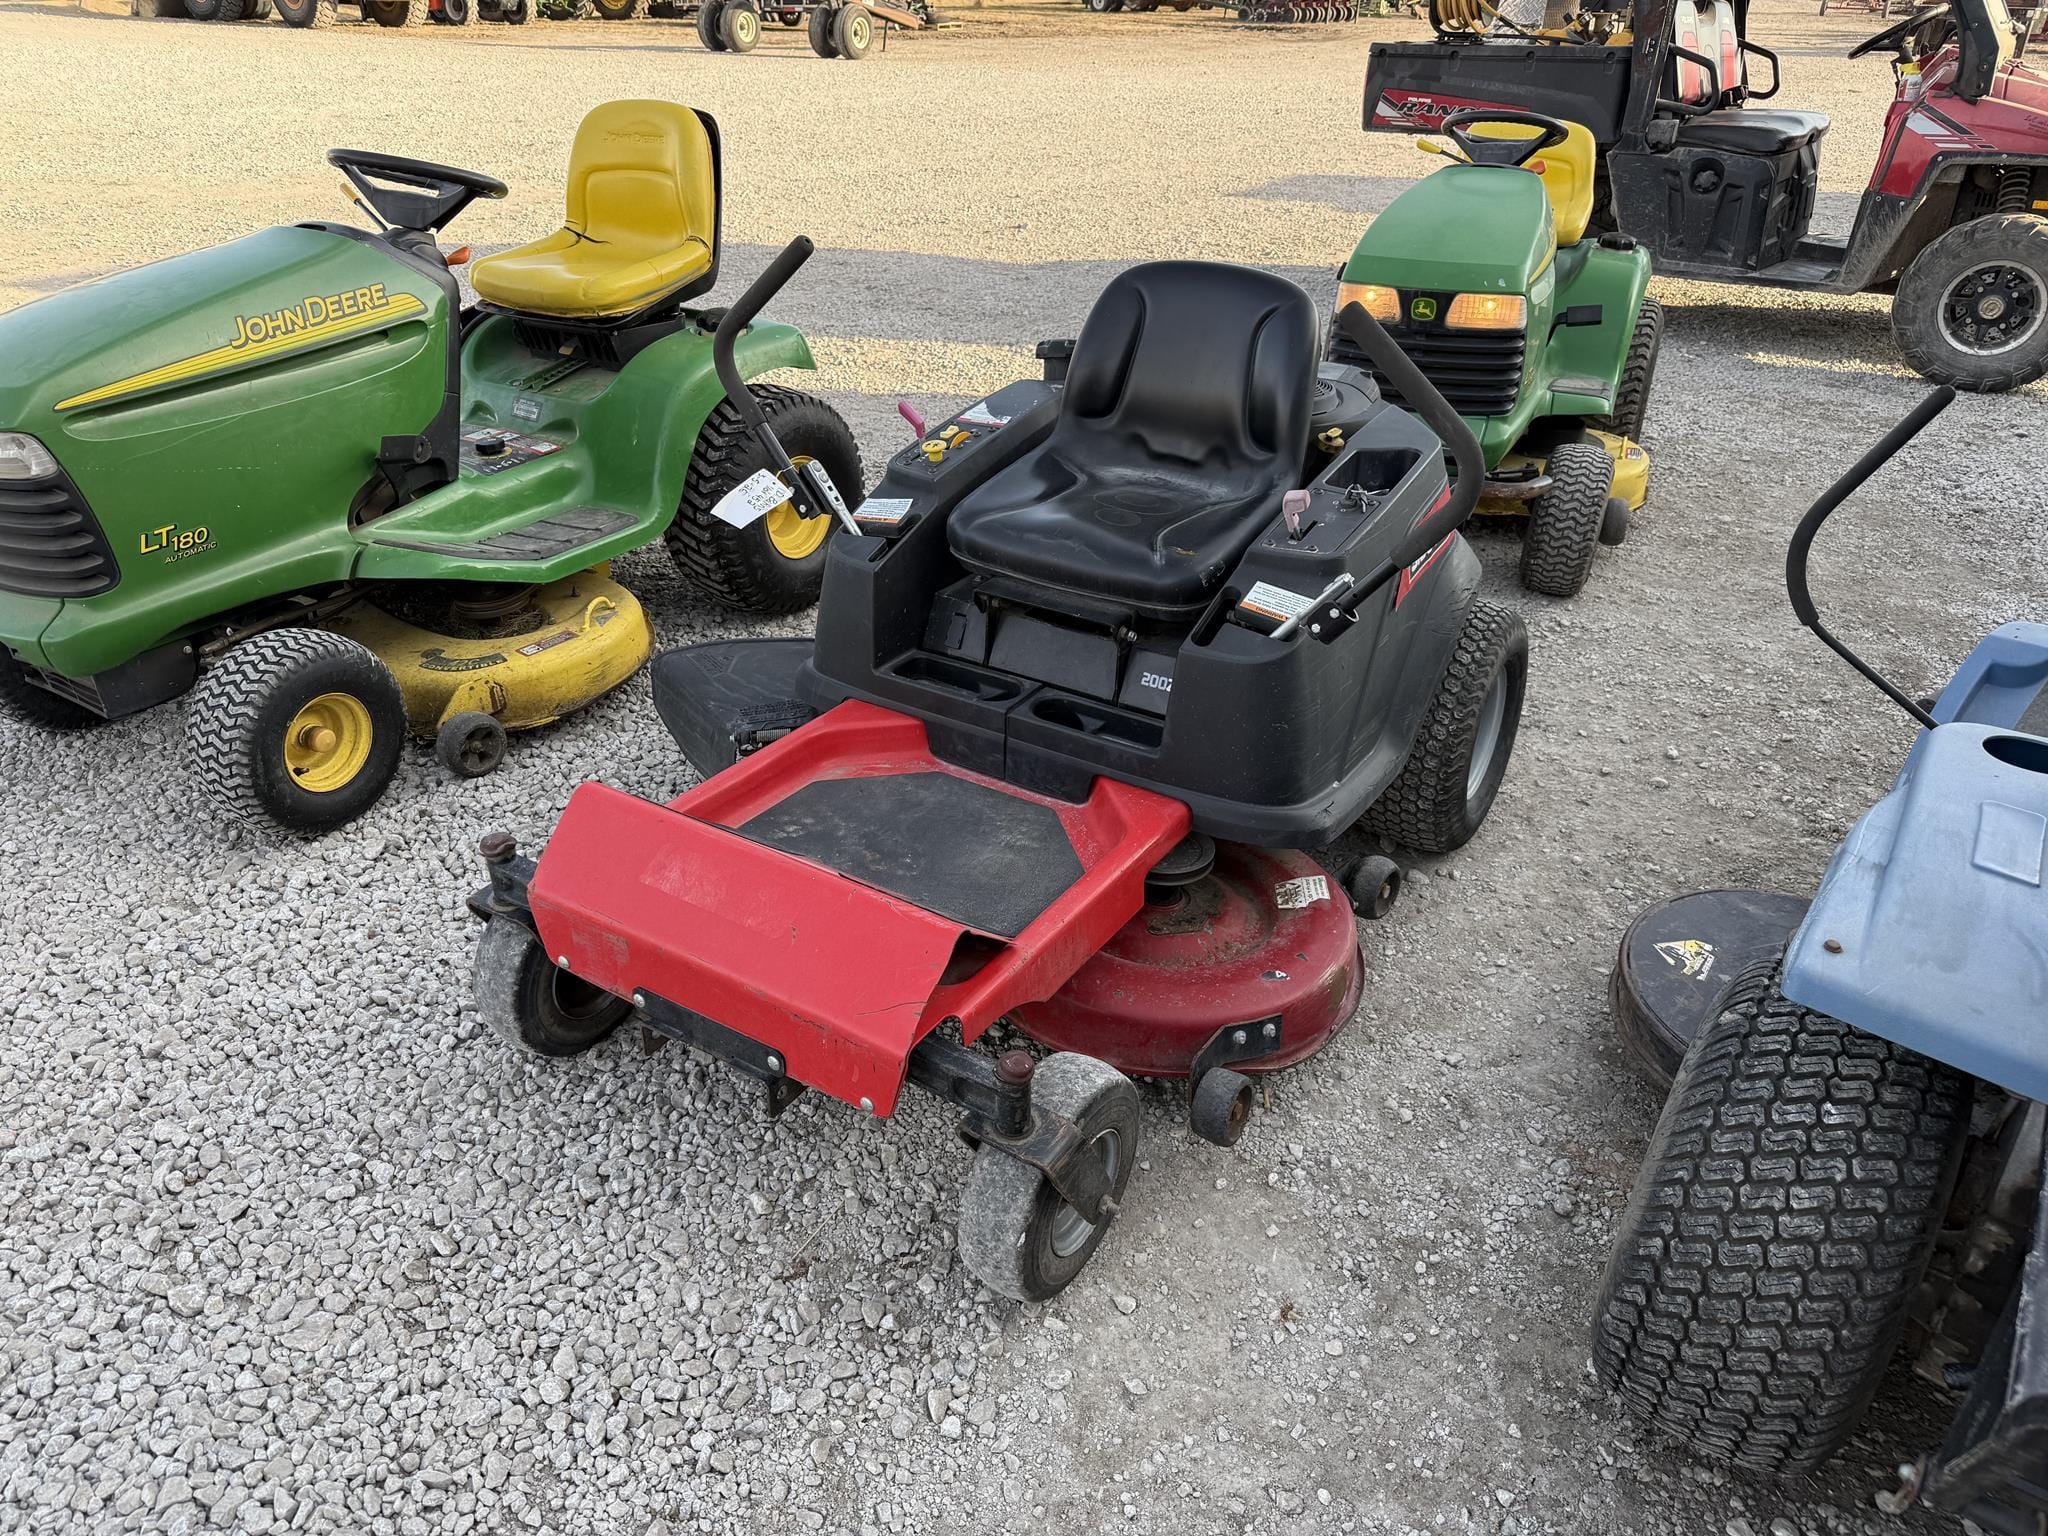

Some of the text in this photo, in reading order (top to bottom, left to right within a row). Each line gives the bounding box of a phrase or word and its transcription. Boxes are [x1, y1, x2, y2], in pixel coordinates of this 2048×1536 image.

[601, 131, 665, 145] JOHN DEERE
[231, 282, 390, 349] JOHN DEERE
[164, 541, 218, 564] AUTOMATIC
